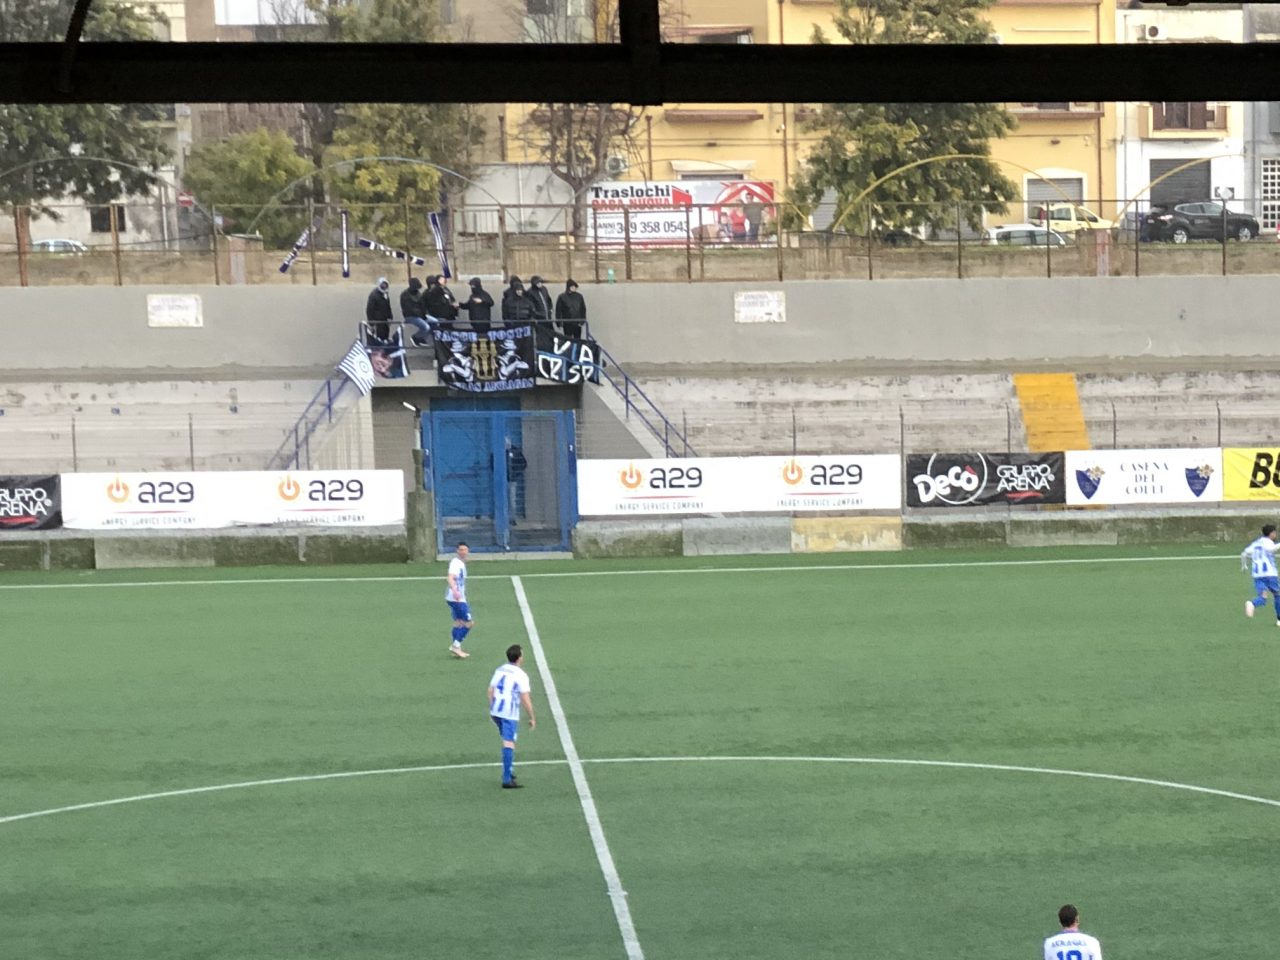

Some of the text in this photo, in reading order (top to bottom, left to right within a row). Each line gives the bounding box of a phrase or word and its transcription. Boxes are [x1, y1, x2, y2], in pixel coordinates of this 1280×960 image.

[591, 185, 670, 199] Traslochi
[616, 222, 637, 234] 39
[639, 221, 660, 233] 358
[649, 467, 703, 489] a29
[810, 464, 863, 485] a29
[997, 464, 1051, 478] GRUPPO
[138, 481, 194, 503] a29
[308, 479, 364, 501] a29
[997, 477, 1050, 491] ARENA
[497, 675, 506, 694] 4
